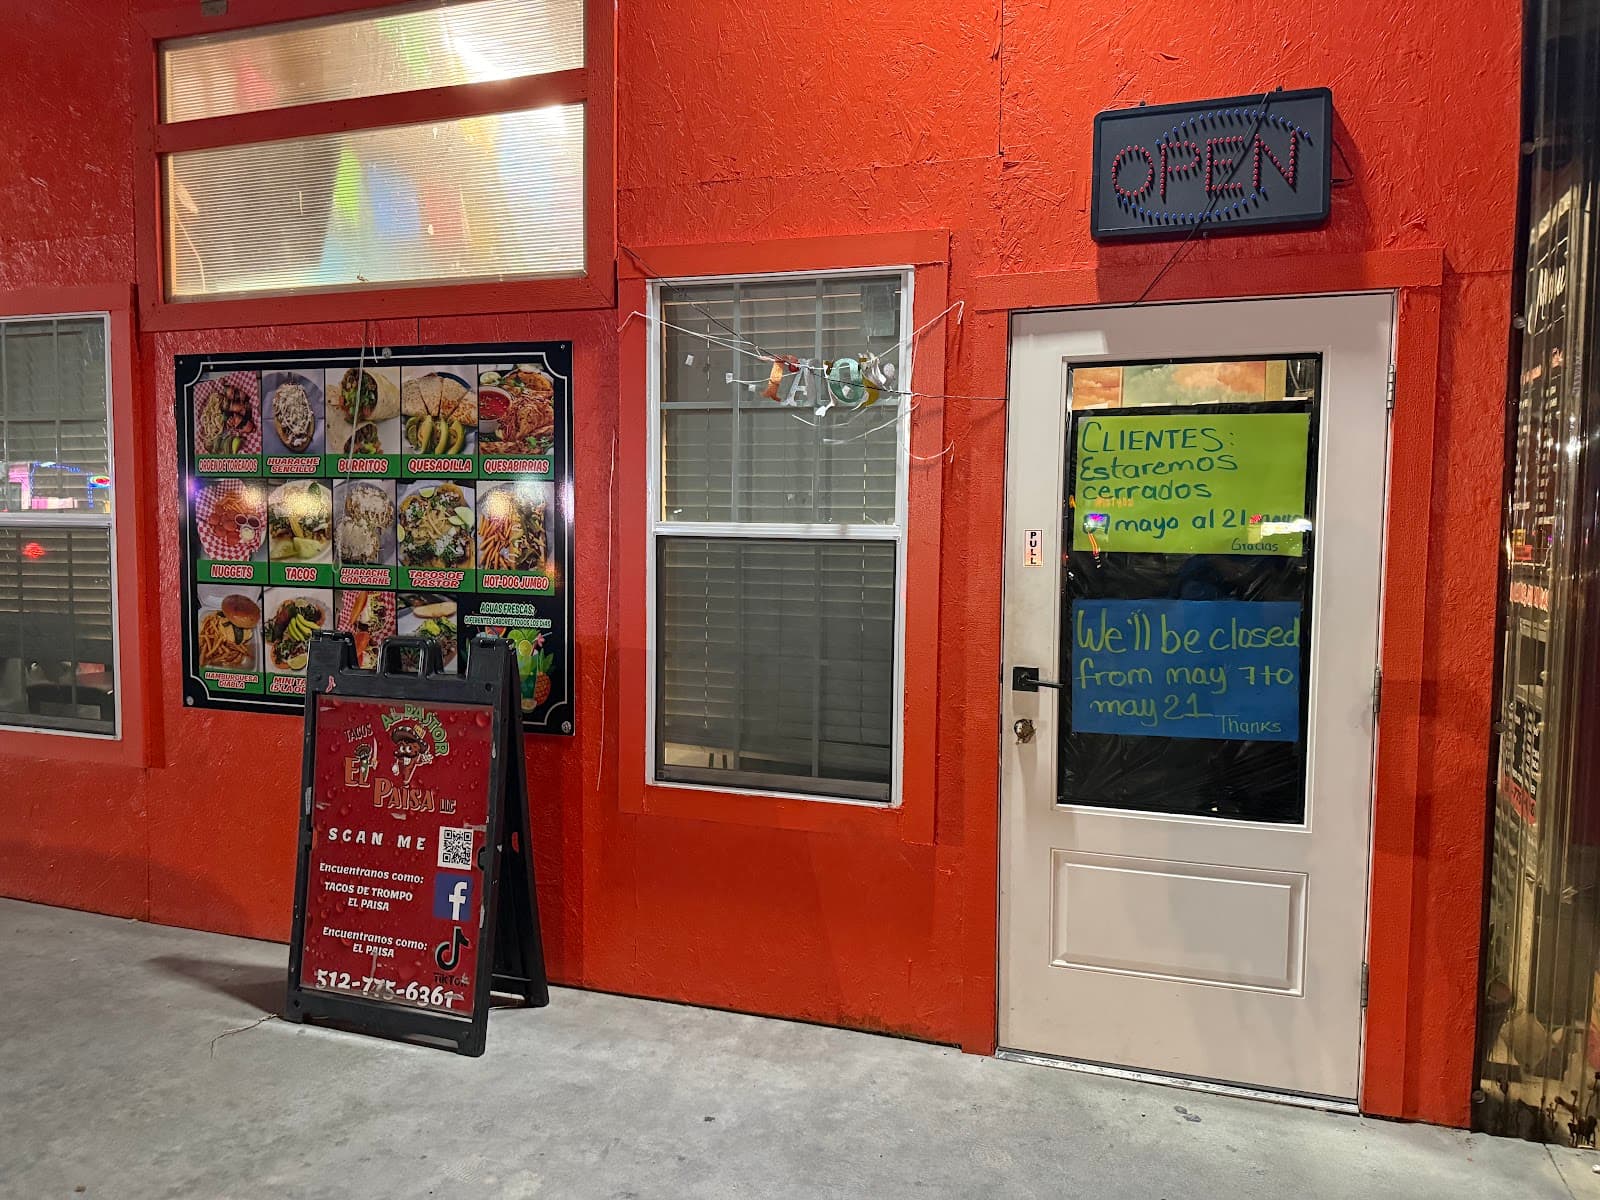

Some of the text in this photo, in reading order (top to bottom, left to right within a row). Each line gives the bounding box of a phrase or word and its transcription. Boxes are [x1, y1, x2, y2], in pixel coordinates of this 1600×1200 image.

[1111, 129, 1297, 197] OPEN
[267, 457, 320, 466] HUARACHE
[338, 458, 388, 473] BURRITOS
[408, 459, 472, 473] QUESADILLA
[484, 459, 549, 474] QUESABIRRIAS
[1080, 454, 1238, 481] Estaremos
[271, 465, 316, 474] SENCILLO
[1082, 480, 1213, 500] cerrados
[1115, 517, 1179, 539] mayo
[1192, 508, 1214, 529] al
[1222, 508, 1247, 528] 21
[1231, 537, 1279, 552] Gracias
[211, 565, 253, 579] NUGGETS
[285, 567, 317, 581] TACOS
[341, 568, 389, 577] HUARACHE
[409, 570, 464, 580] TACOS DE
[340, 576, 391, 586] CON CARNE
[412, 578, 460, 588] PASTOR
[483, 575, 549, 589] HOT-DOG JUMBO
[480, 602, 502, 614] AGUAS
[1161, 613, 1203, 654] be
[1209, 616, 1300, 650] closed
[205, 672, 259, 683] HAMBURGUESA
[273, 676, 296, 686] MINI
[1075, 658, 1153, 689] from
[1166, 667, 1228, 694] may
[218, 680, 246, 689] DIABLA
[280, 684, 294, 694] LA
[1090, 698, 1159, 727] may
[404, 704, 449, 757] PASTOR
[1213, 714, 1282, 735] Thanks
[344, 723, 373, 743] TACOS
[328, 827, 427, 850] SCAN ME
[319, 863, 424, 884] Encuentranos como:
[324, 881, 413, 902] TACOS DE TROMPO
[347, 897, 390, 911] EL PAISA
[322, 926, 428, 951] Encuentranos como:
[352, 943, 395, 958] EL PAISA
